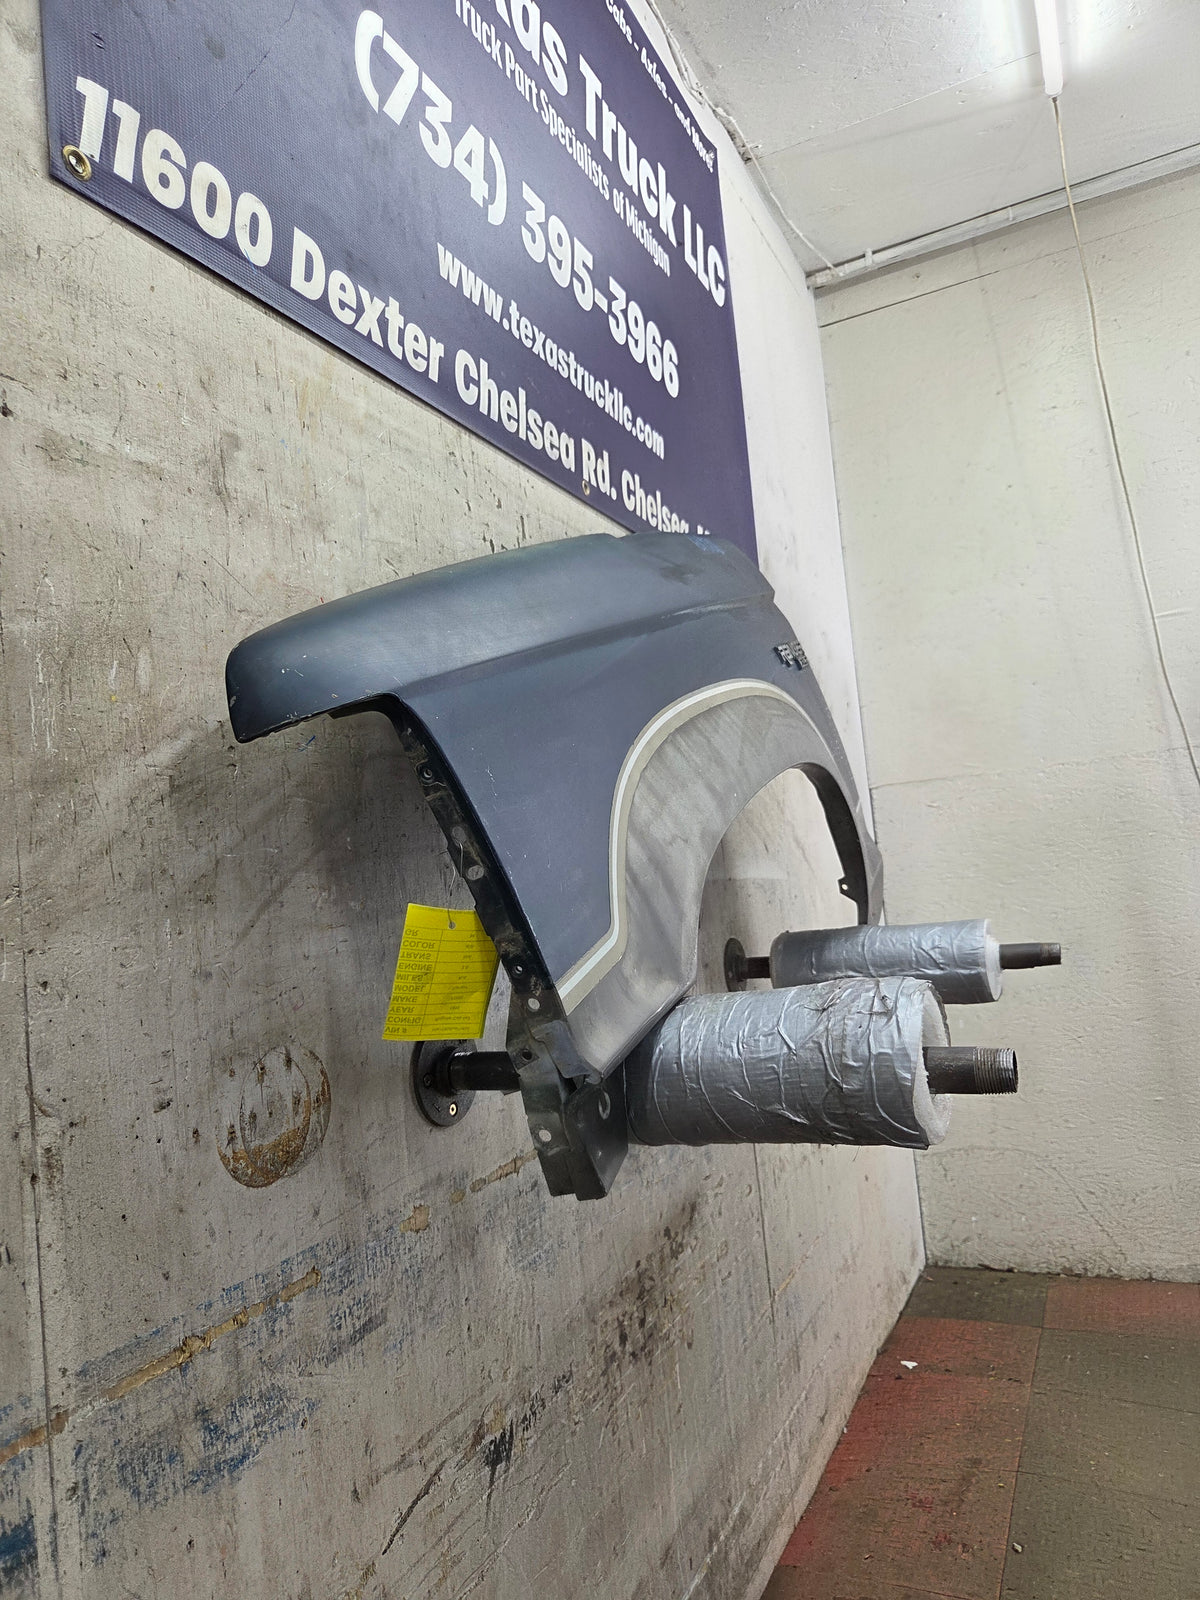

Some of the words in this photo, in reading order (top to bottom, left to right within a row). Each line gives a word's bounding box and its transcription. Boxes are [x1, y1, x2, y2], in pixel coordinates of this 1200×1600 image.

[354, 10, 507, 225] (734)
[521, 180, 679, 398] 395-3966
[504, 41, 539, 113] Part
[540, 88, 610, 201] Specialists
[612, 188, 624, 220] of
[625, 197, 671, 278] Michigan
[579, 54, 677, 248] Truck
[683, 204, 726, 307] LLC
[641, 47, 667, 98] Axles
[674, 103, 691, 136] and
[76, 76, 273, 267] 11600
[290, 226, 444, 383] Dexter
[455, 349, 575, 472] Chelsea
[582, 438, 617, 501] Rd.
[437, 242, 665, 461] www.texastruckllc.com
